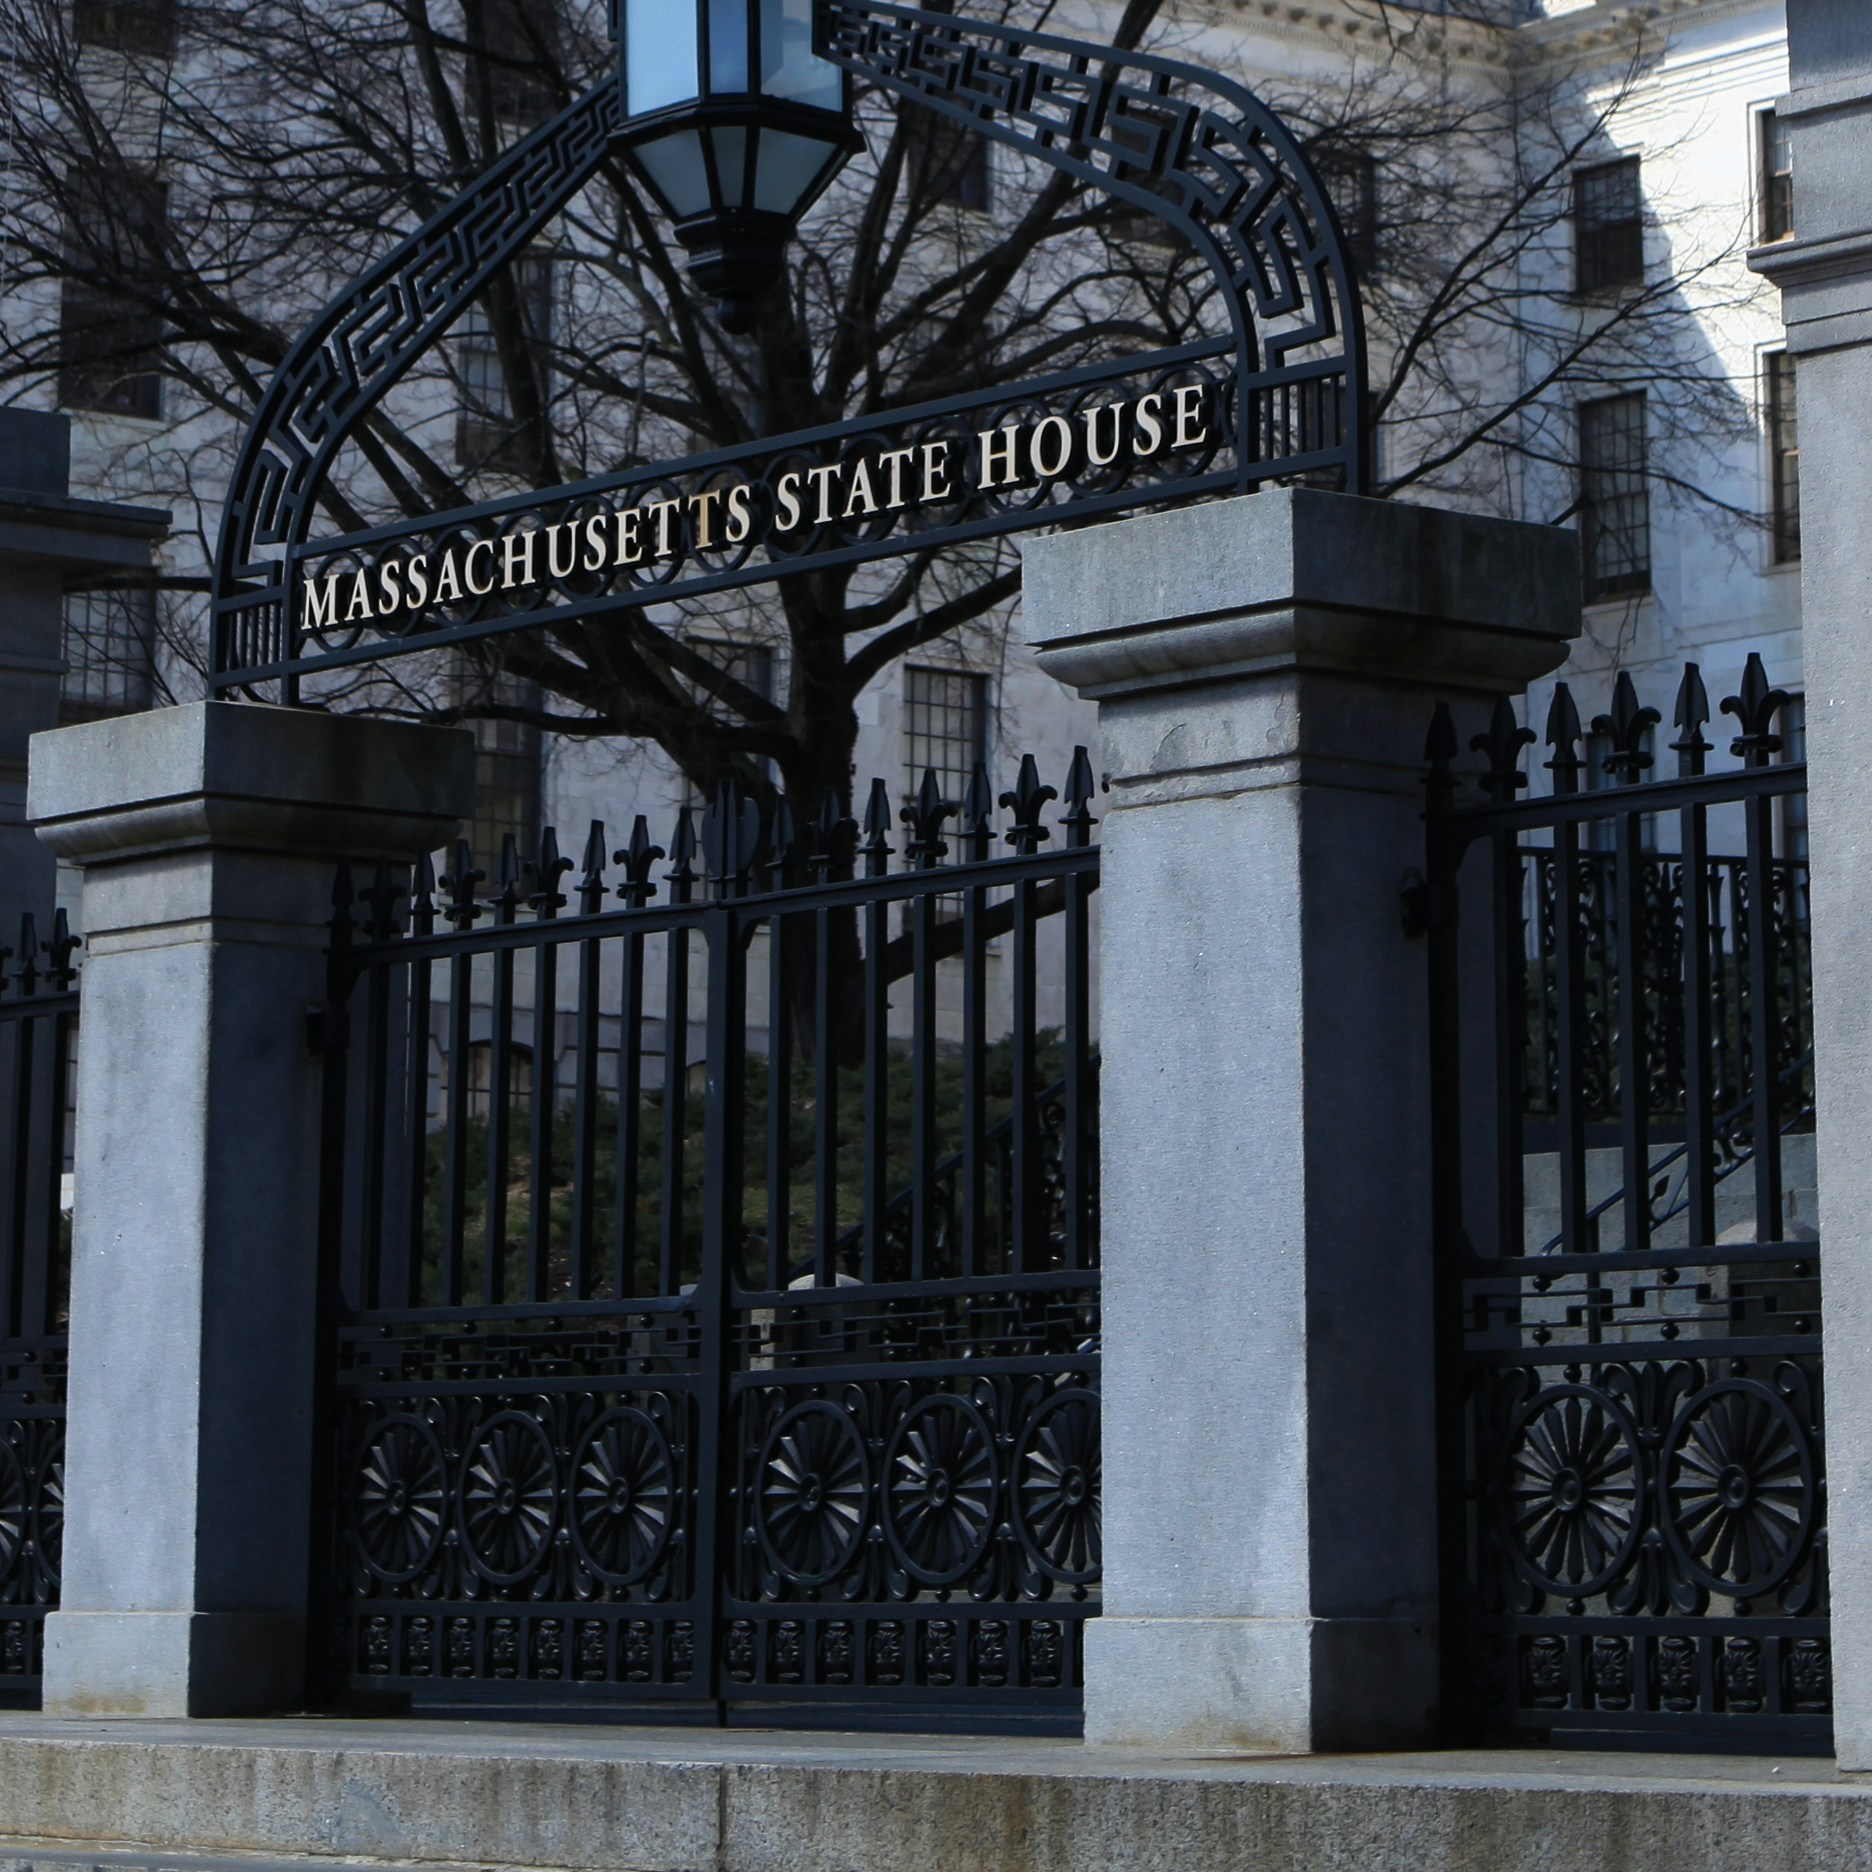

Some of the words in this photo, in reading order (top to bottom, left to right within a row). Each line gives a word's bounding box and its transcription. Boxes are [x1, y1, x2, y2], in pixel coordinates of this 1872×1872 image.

[301, 485, 751, 631] MASSACHUSETTS
[774, 440, 951, 533] STATE
[978, 383, 1207, 489] HOUSE
